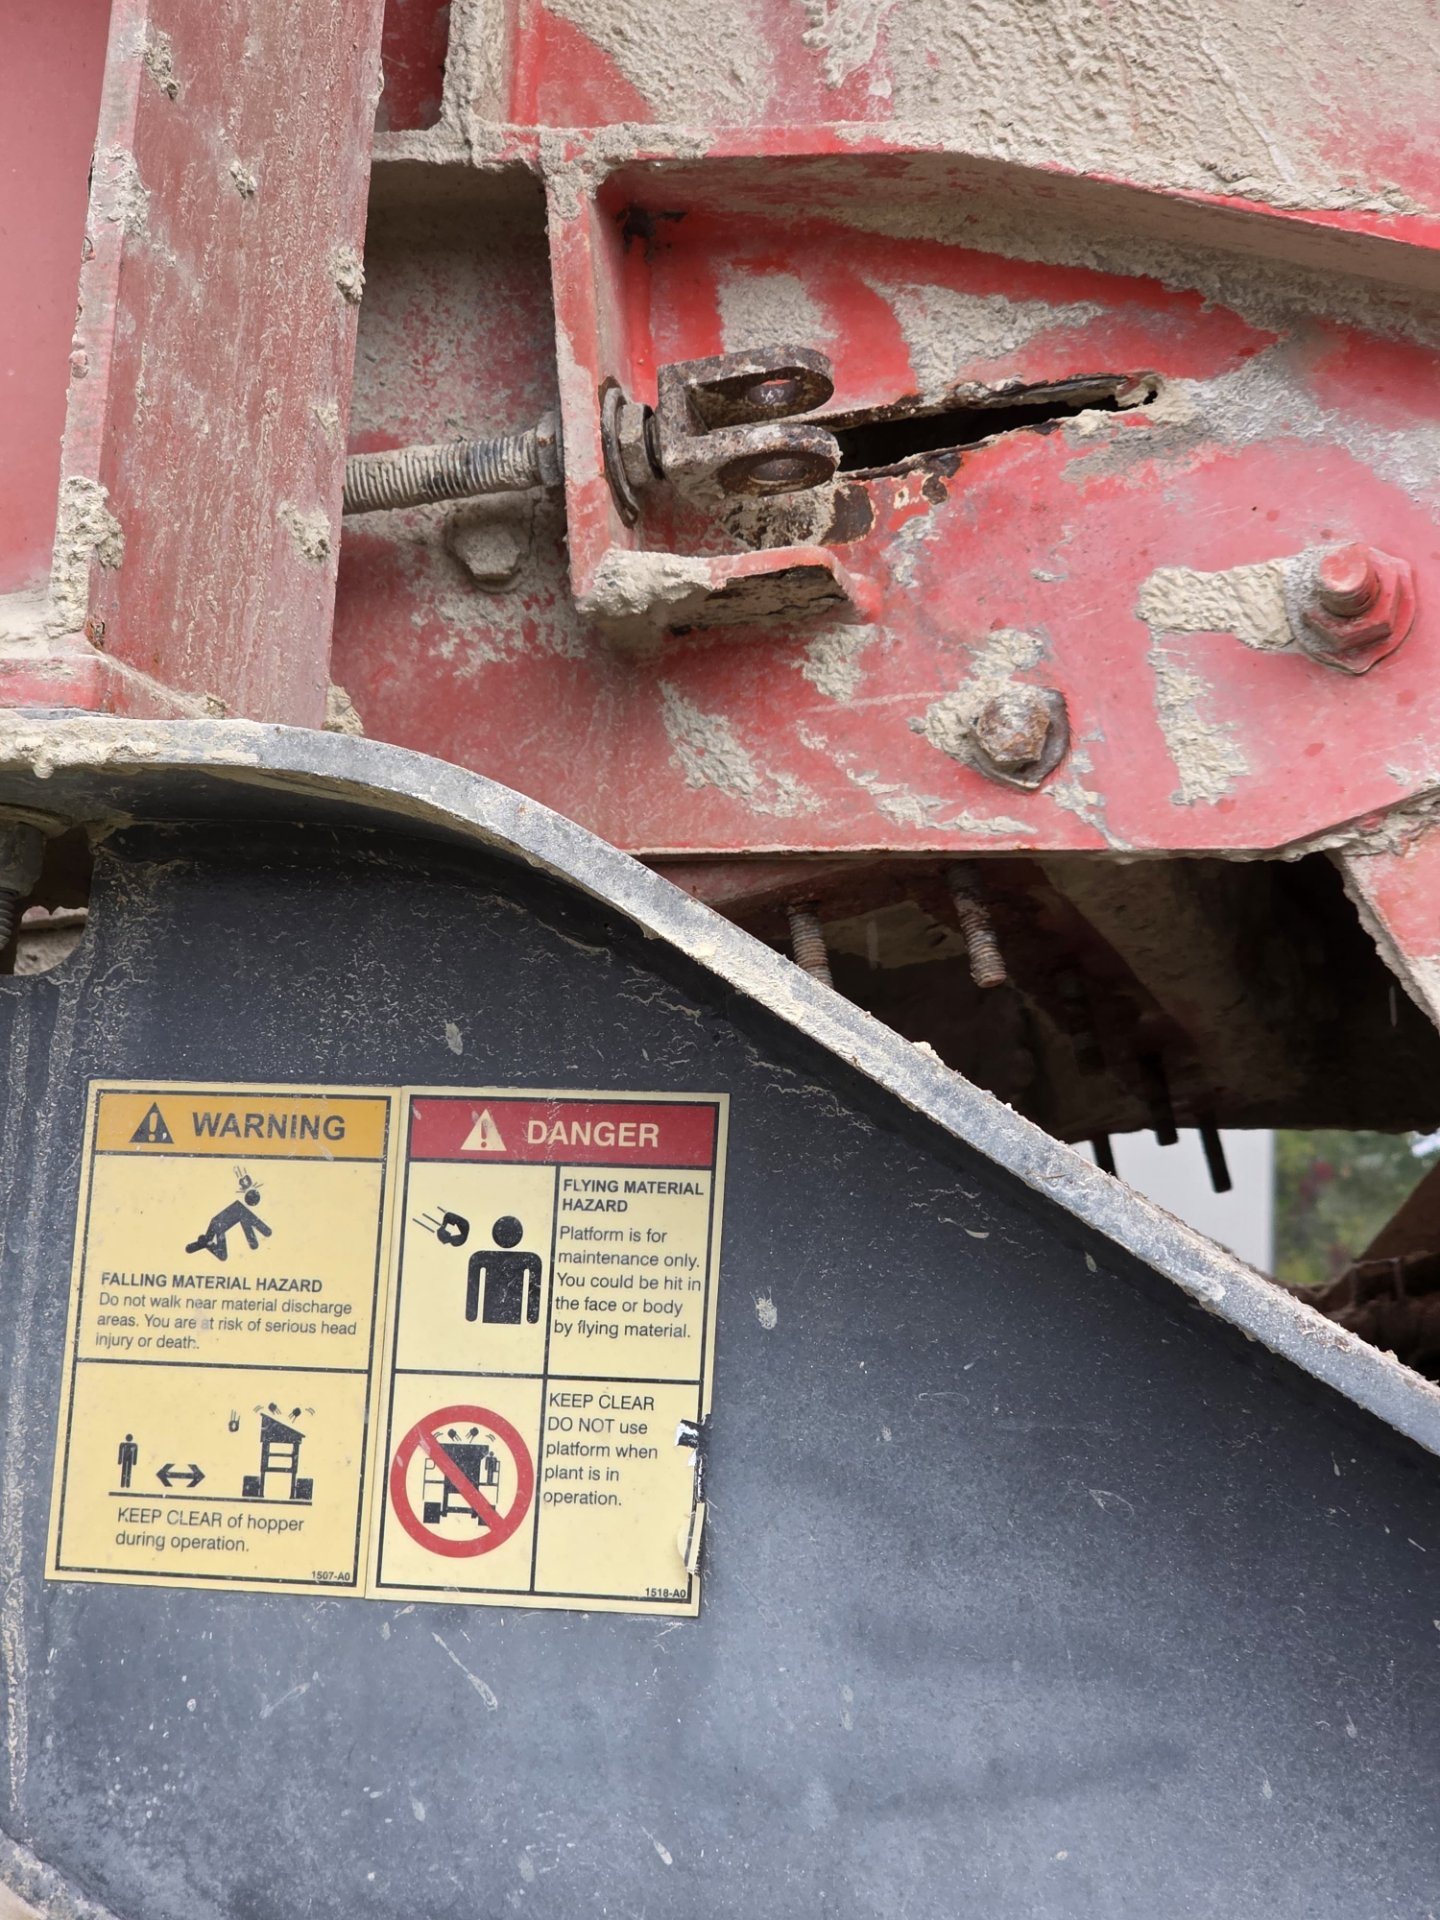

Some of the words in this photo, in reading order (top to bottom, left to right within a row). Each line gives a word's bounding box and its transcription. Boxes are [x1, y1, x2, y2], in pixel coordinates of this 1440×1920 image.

[192, 1111, 346, 1141] WARNING
[527, 1120, 660, 1148] DANGER
[563, 1179, 619, 1193] FLYING
[624, 1181, 704, 1195] MATERIAL
[562, 1199, 628, 1213] HAZARD
[560, 1225, 623, 1241] Platform
[629, 1228, 641, 1242] is
[646, 1228, 668, 1244] for
[558, 1250, 659, 1266] maintenance
[664, 1254, 700, 1271] only.
[101, 1272, 167, 1288] FALLING
[172, 1275, 250, 1291] MATERIAL
[256, 1278, 322, 1293] HAZARD
[556, 1273, 585, 1287] You
[590, 1274, 633, 1289] could
[639, 1276, 659, 1290] be
[664, 1276, 683, 1291] hit
[687, 1277, 701, 1291] in
[99, 1292, 119, 1307] Do
[123, 1294, 146, 1308] not
[150, 1295, 181, 1309] walk
[185, 1298, 217, 1310] near
[221, 1298, 277, 1312] material
[281, 1299, 352, 1315] discharge
[555, 1297, 579, 1311] the
[584, 1298, 617, 1312] face
[622, 1301, 638, 1313] or
[643, 1300, 683, 1317] body
[97, 1314, 139, 1327] areas.
[144, 1314, 170, 1329] You
[174, 1318, 196, 1329] are
[218, 1317, 242, 1331] risk
[247, 1319, 261, 1332] of
[265, 1321, 316, 1333] serious
[321, 1321, 356, 1335] head
[554, 1320, 572, 1336] by
[577, 1321, 619, 1339] flying
[624, 1323, 691, 1338] material.
[96, 1335, 133, 1350] injury
[138, 1336, 152, 1348] or
[549, 1393, 594, 1408] KEEP
[598, 1394, 655, 1411] CLEAR
[548, 1416, 573, 1432] DO
[578, 1417, 614, 1433] NOT
[619, 1422, 648, 1435] use
[546, 1441, 610, 1458] platform
[615, 1444, 658, 1459] when
[544, 1465, 583, 1482] plant
[588, 1466, 601, 1481] is
[606, 1467, 619, 1482] in
[543, 1490, 622, 1508] operation.
[118, 1507, 162, 1524] KEEP
[166, 1510, 222, 1528] CLEAR
[227, 1513, 243, 1528] of
[247, 1515, 304, 1534] hopper
[116, 1531, 165, 1550] during
[171, 1534, 249, 1552] operation.
[311, 1571, 350, 1581] 1507-A0
[645, 1588, 686, 1598] 1518-A0
